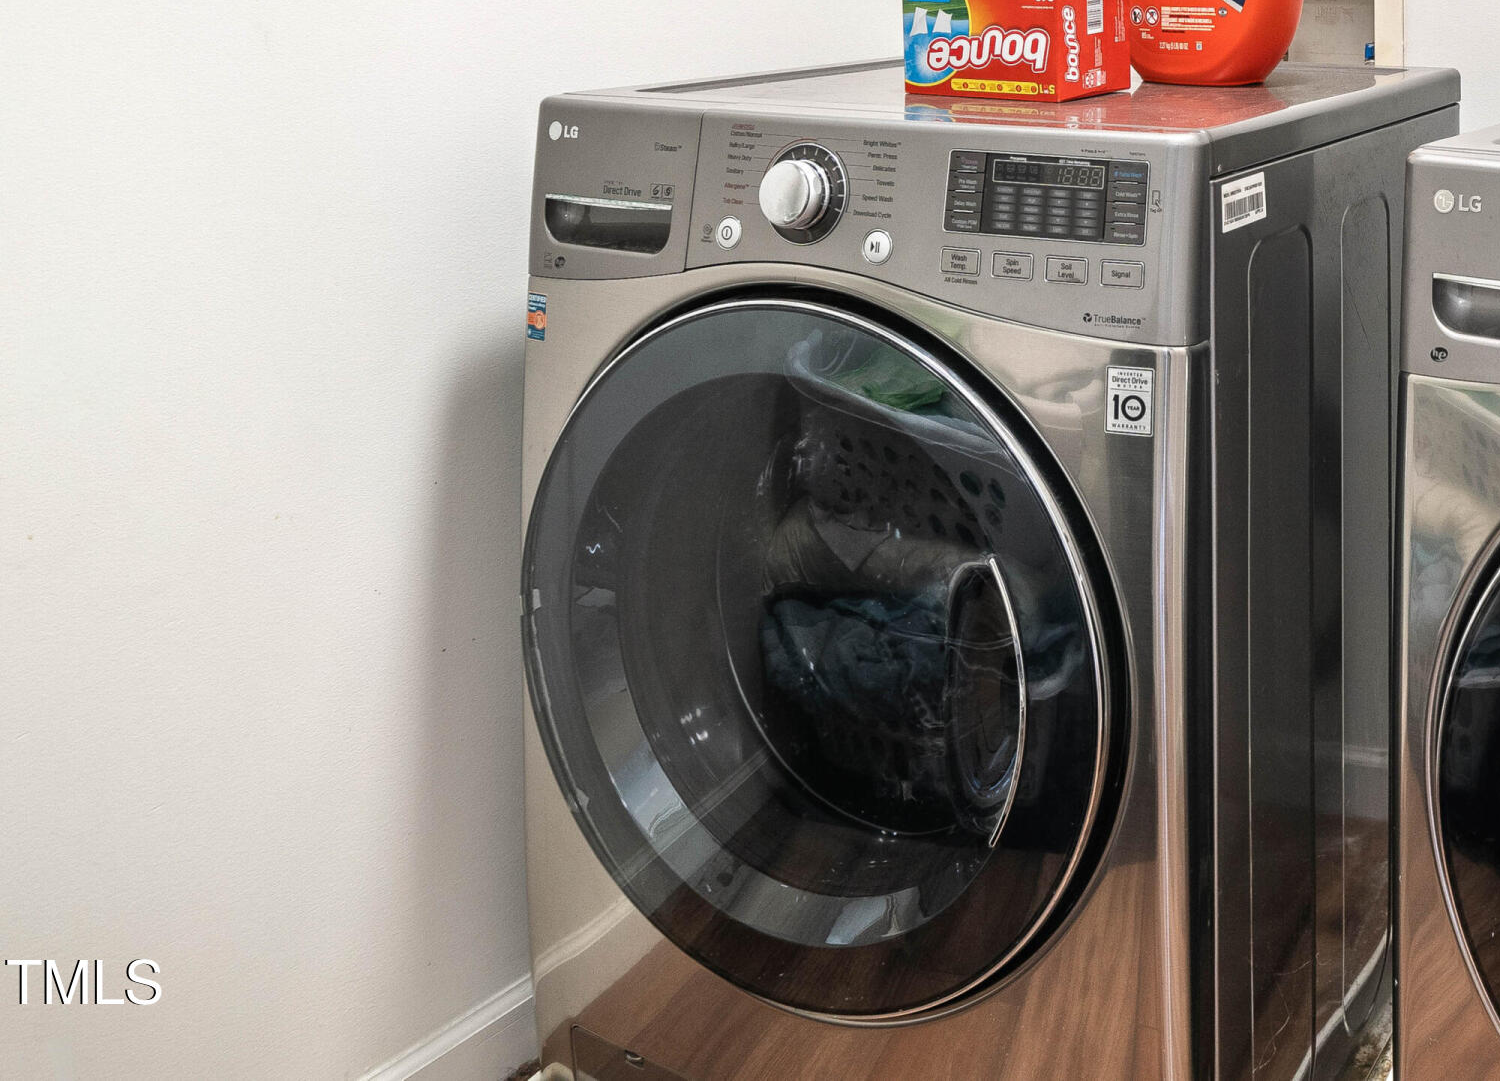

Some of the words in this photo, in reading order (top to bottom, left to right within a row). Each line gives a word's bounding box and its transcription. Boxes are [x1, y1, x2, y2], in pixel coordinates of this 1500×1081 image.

[928, 27, 1049, 72] bounce
[1062, 6, 1080, 82] bounce
[564, 125, 579, 138] LG
[603, 185, 623, 195] Direct
[624, 187, 641, 196] Drive
[1458, 194, 1482, 212] LG
[951, 254, 967, 262] Wash
[1002, 266, 1022, 275] Speed
[1057, 271, 1074, 279] Level
[1111, 270, 1131, 279] Signal
[1113, 394, 1146, 421] 10
